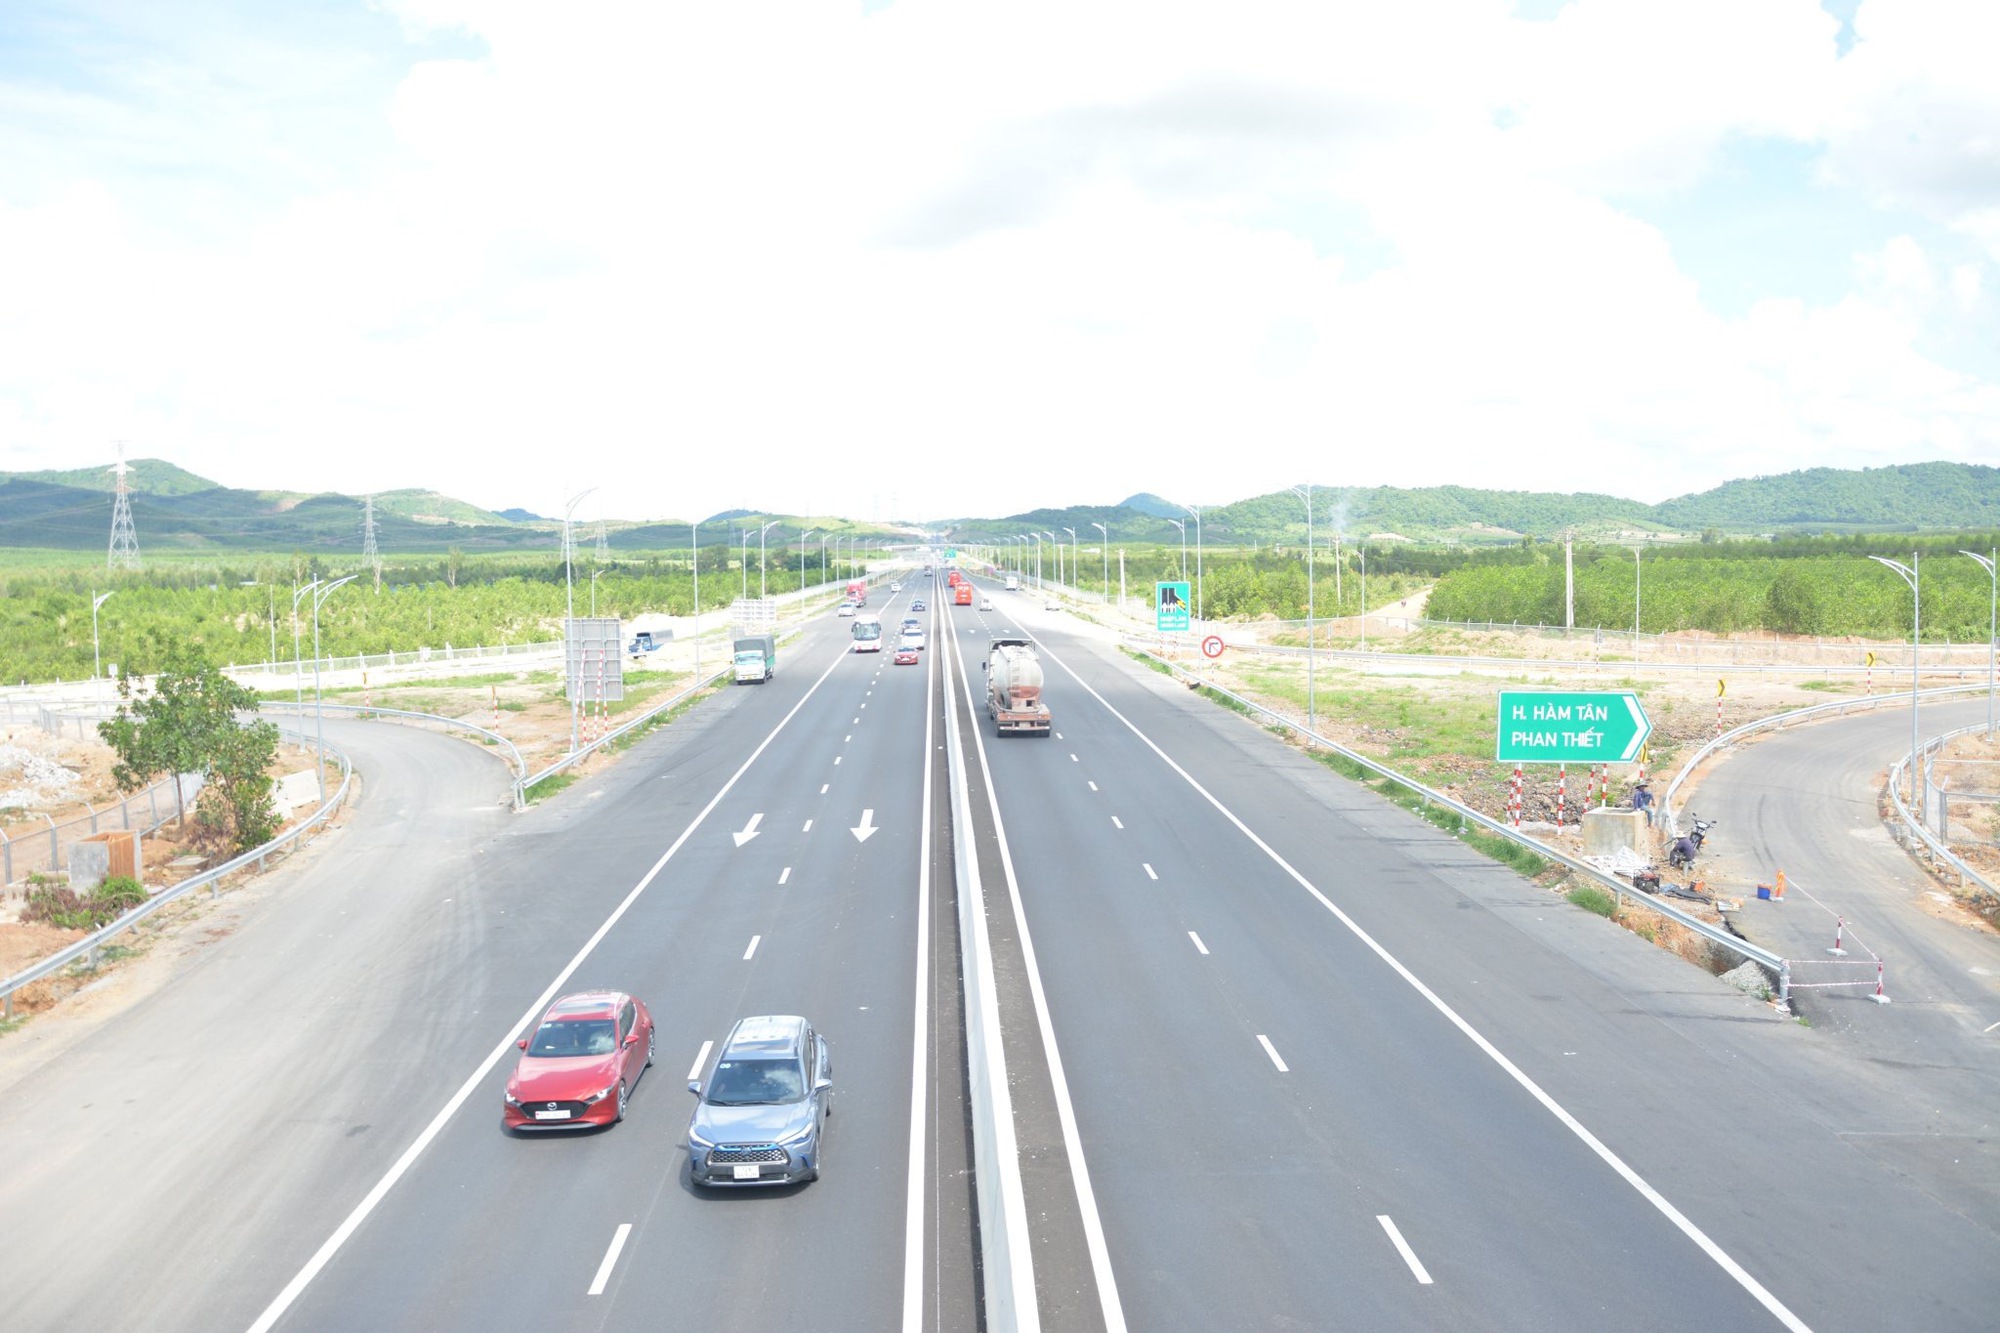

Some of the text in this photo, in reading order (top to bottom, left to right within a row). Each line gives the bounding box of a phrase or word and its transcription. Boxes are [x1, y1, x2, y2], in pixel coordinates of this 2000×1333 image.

[1512, 702, 1608, 721] H. HÀM TÂN
[1511, 726, 1604, 747] PHAN THIẾT
